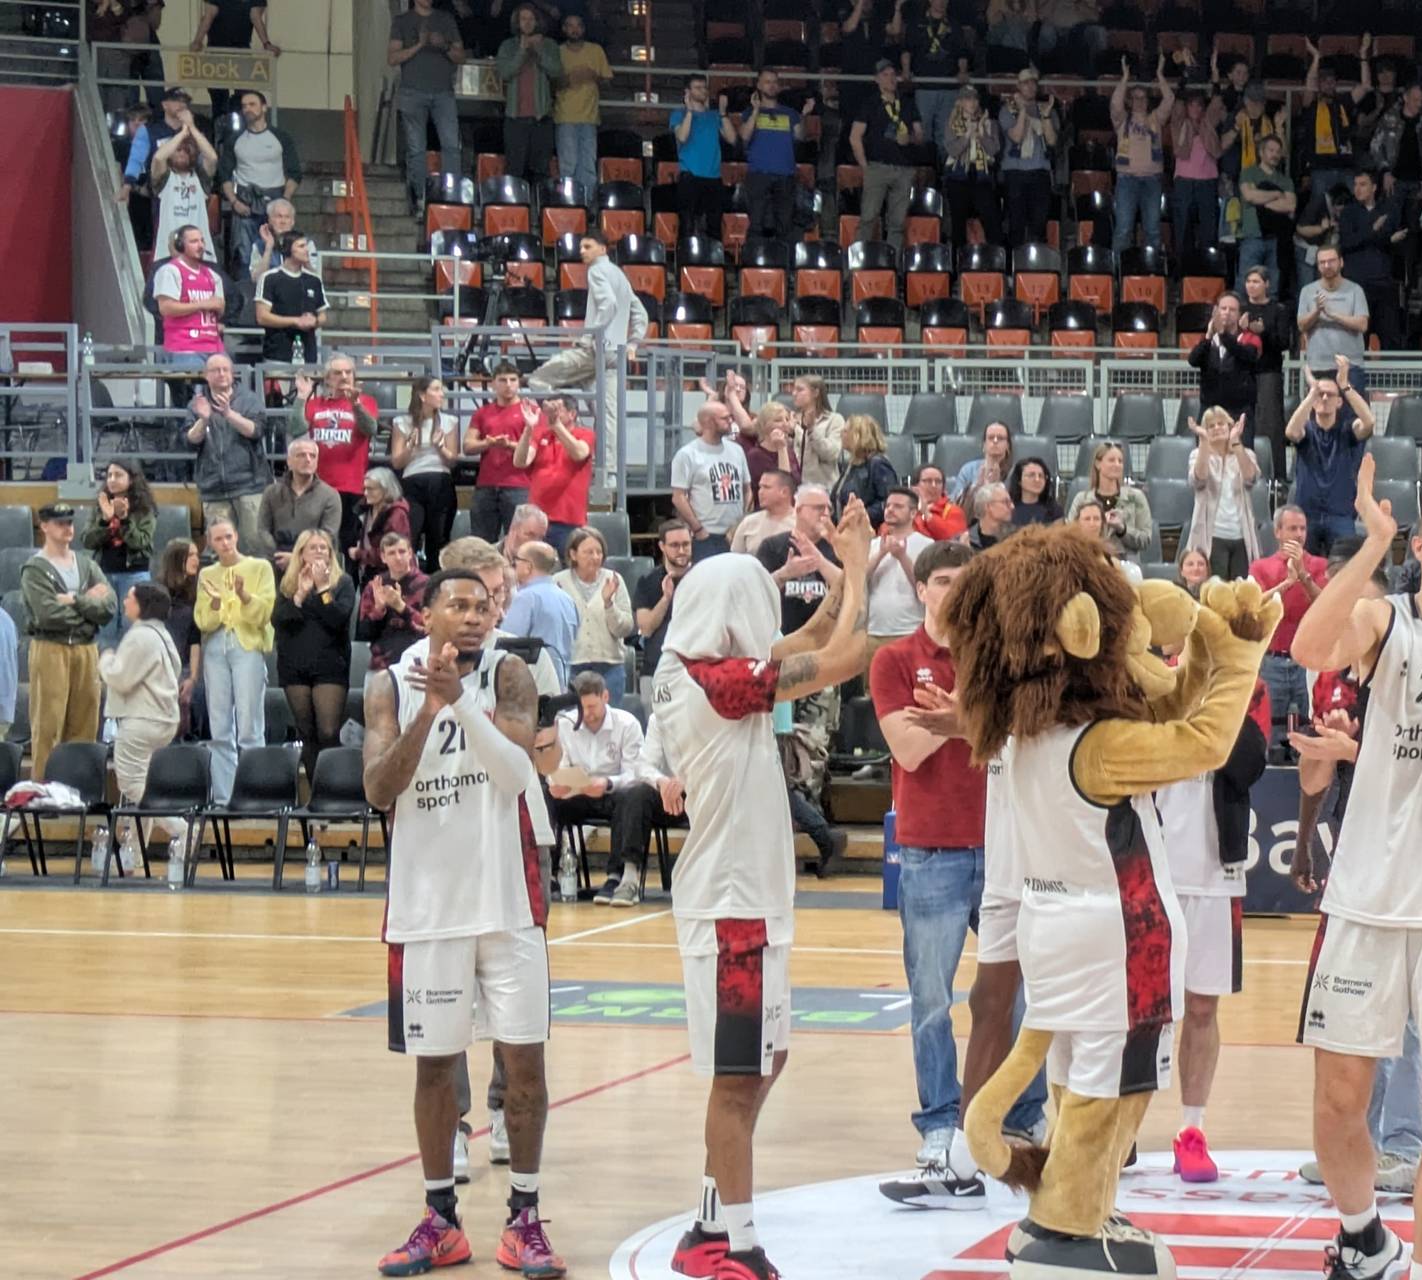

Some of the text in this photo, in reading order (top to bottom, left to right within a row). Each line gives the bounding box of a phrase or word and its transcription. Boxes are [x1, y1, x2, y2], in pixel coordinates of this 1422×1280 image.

[182, 56, 268, 80] Block A
[438, 719, 466, 755] 21
[416, 793, 461, 810] sport
